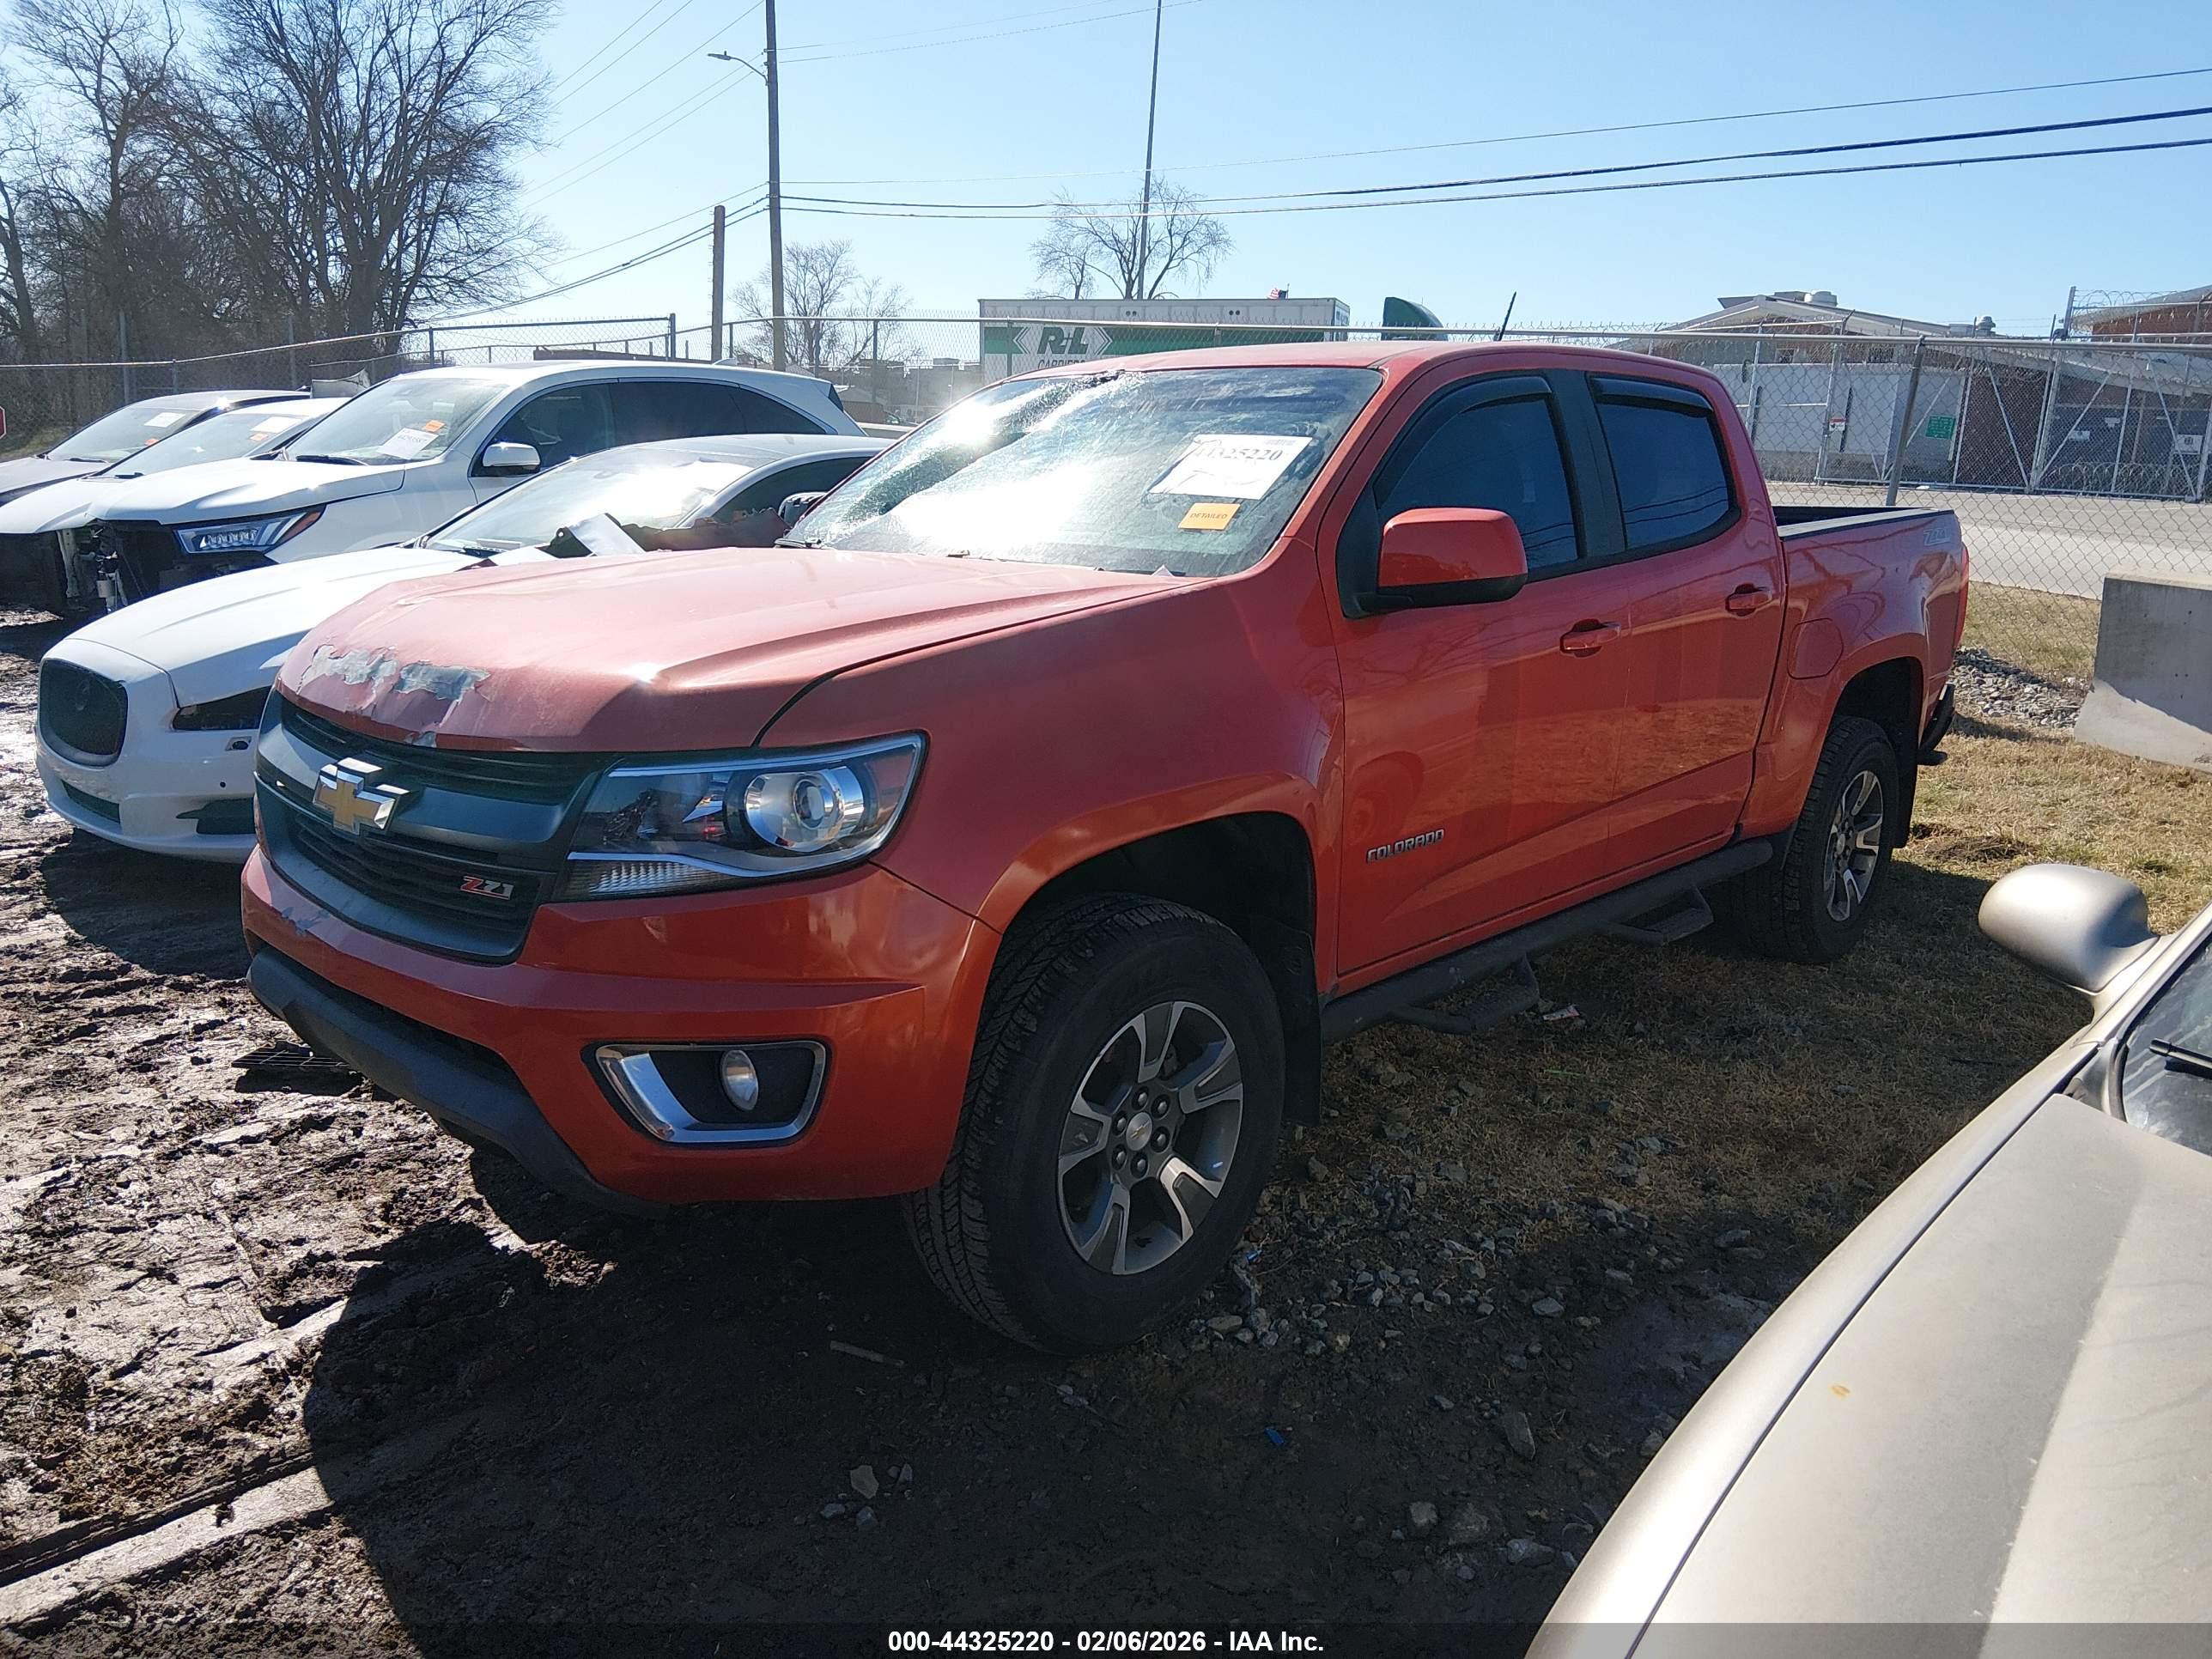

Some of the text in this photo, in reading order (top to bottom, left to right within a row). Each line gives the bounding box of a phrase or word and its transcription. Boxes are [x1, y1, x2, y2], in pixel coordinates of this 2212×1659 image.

[1037, 359, 1086, 370] CARRI
[1366, 829, 1445, 864] COLORADO
[459, 875, 515, 900] Z71
